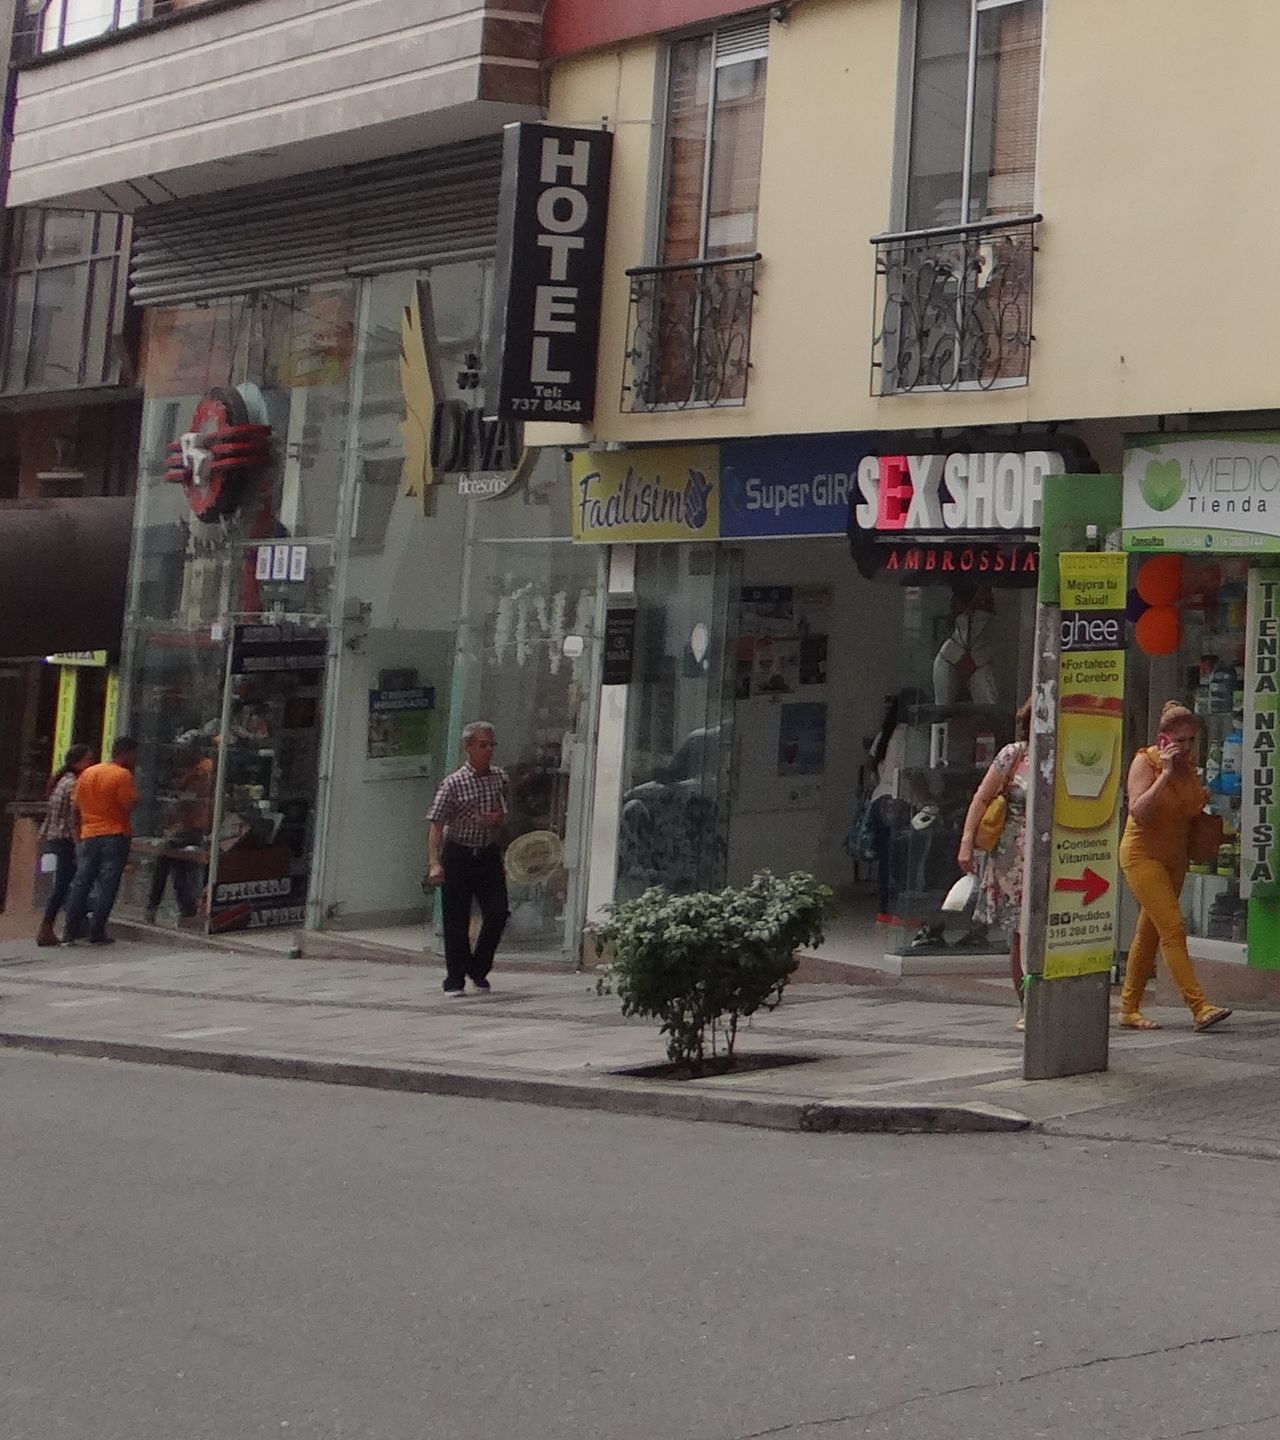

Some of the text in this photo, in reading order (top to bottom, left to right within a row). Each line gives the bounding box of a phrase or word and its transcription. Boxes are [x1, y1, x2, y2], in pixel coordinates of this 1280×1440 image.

[530, 137, 591, 384] HOTEL
[534, 385, 562, 398] Tel:
[512, 399, 582, 412] 737 8454
[856, 450, 1058, 530] SEX SHOP
[1188, 496, 1267, 513] Tienda
[886, 549, 1038, 572] AMBROSSIA
[1067, 579, 1105, 593] Mejora
[1060, 612, 1119, 649] ghee
[1249, 582, 1279, 882] TIENDA NATURISTA
